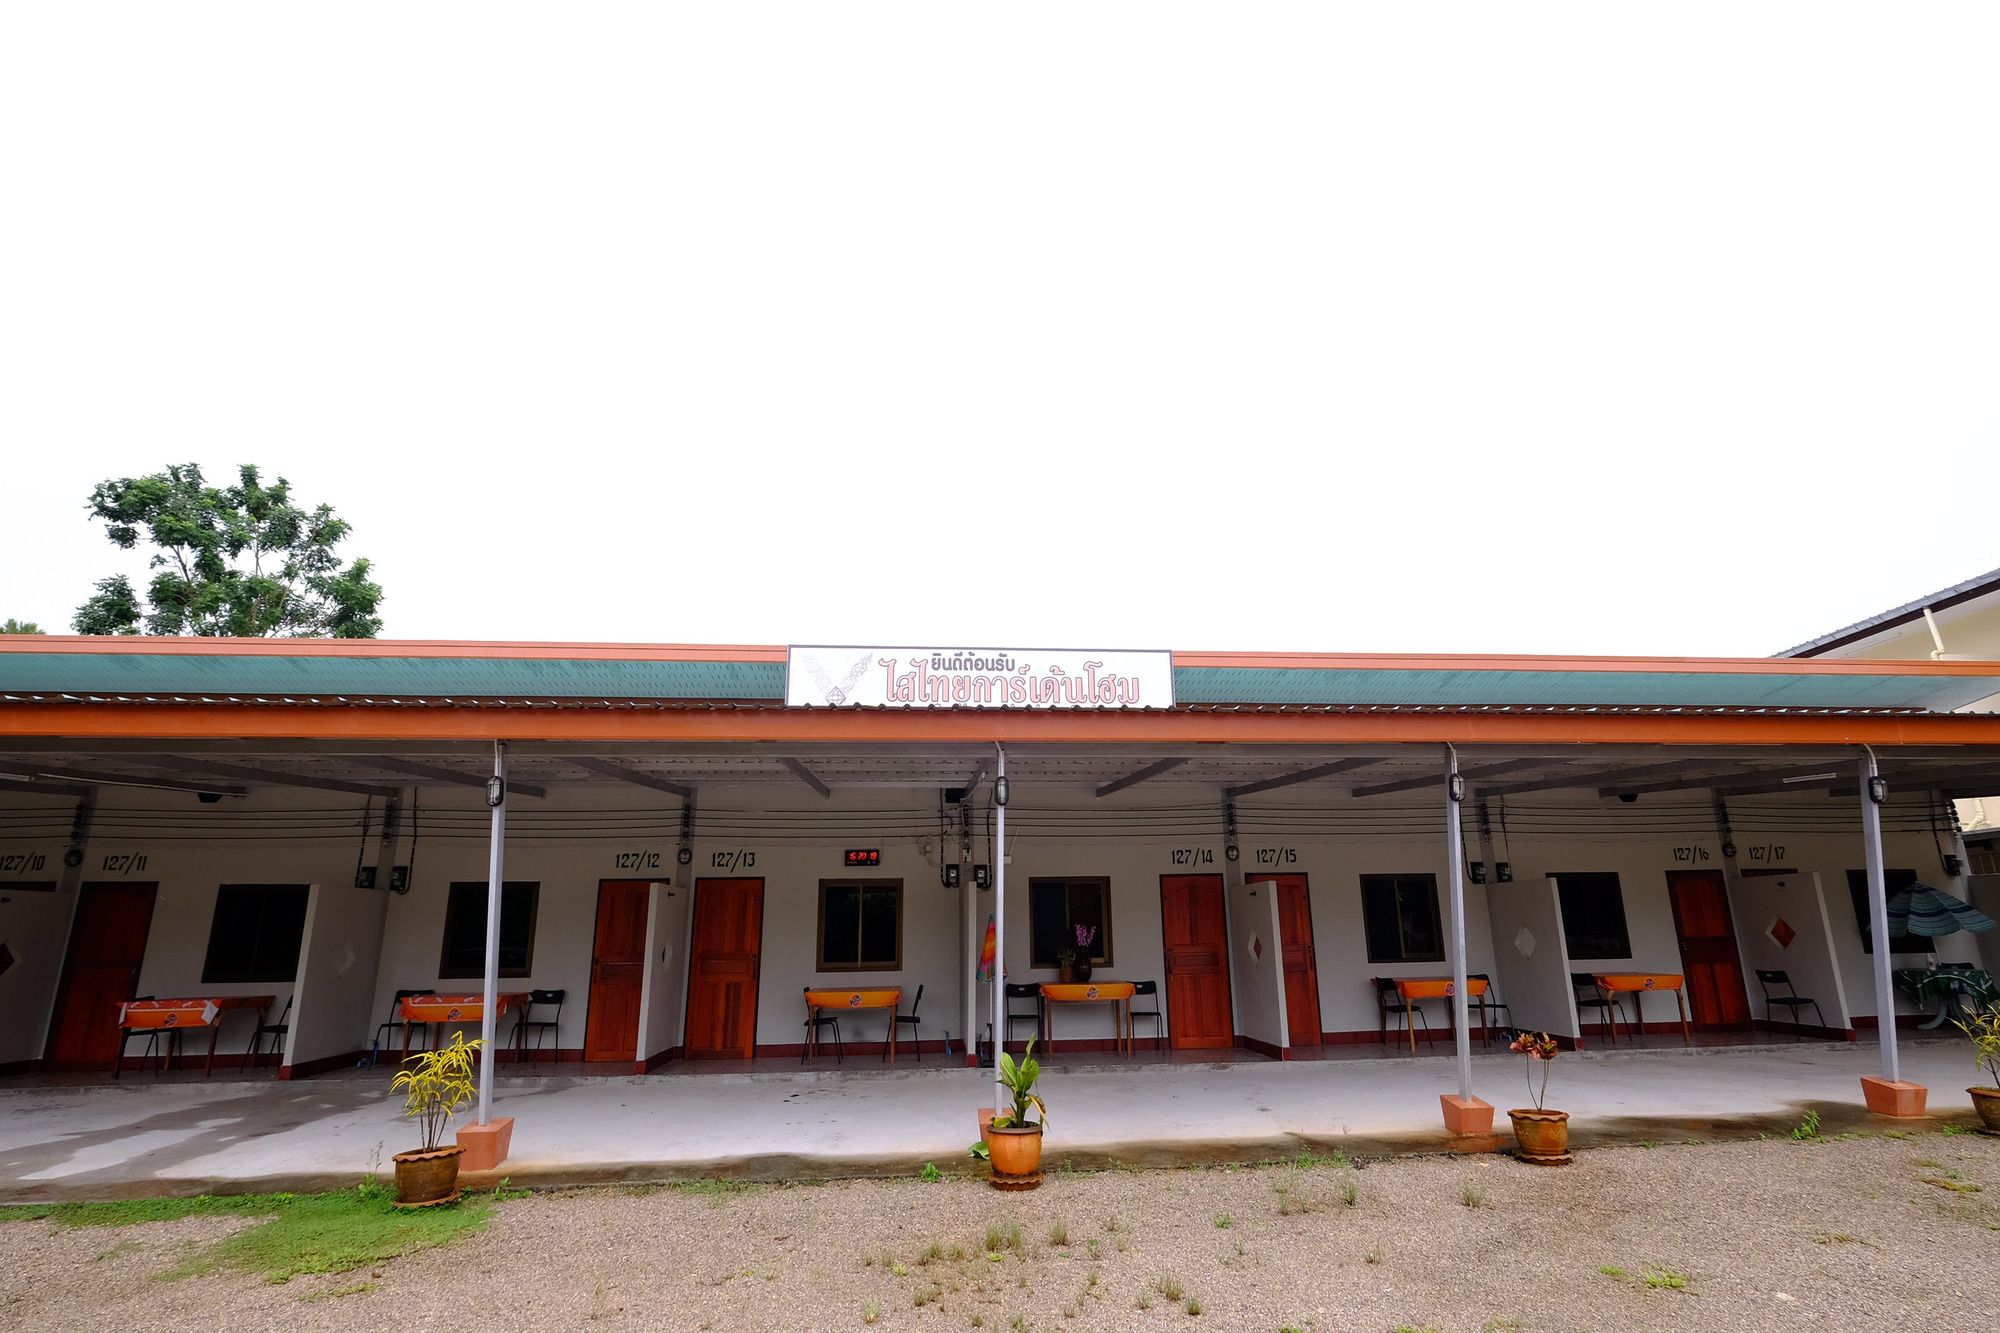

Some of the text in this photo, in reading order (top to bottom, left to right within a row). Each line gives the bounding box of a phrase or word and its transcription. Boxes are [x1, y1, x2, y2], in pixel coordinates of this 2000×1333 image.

[931, 652, 1016, 672] ยินดีต้อนรับ
[0, 851, 46, 874] 127/10
[615, 850, 660, 872] 127/12
[711, 849, 756, 873] 127/13
[1171, 848, 1213, 867] 127/14
[1256, 847, 1297, 867] 127/15
[1673, 845, 1709, 864] 127/16
[1748, 844, 1785, 863] 127/17
[102, 852, 148, 876] 127/11
